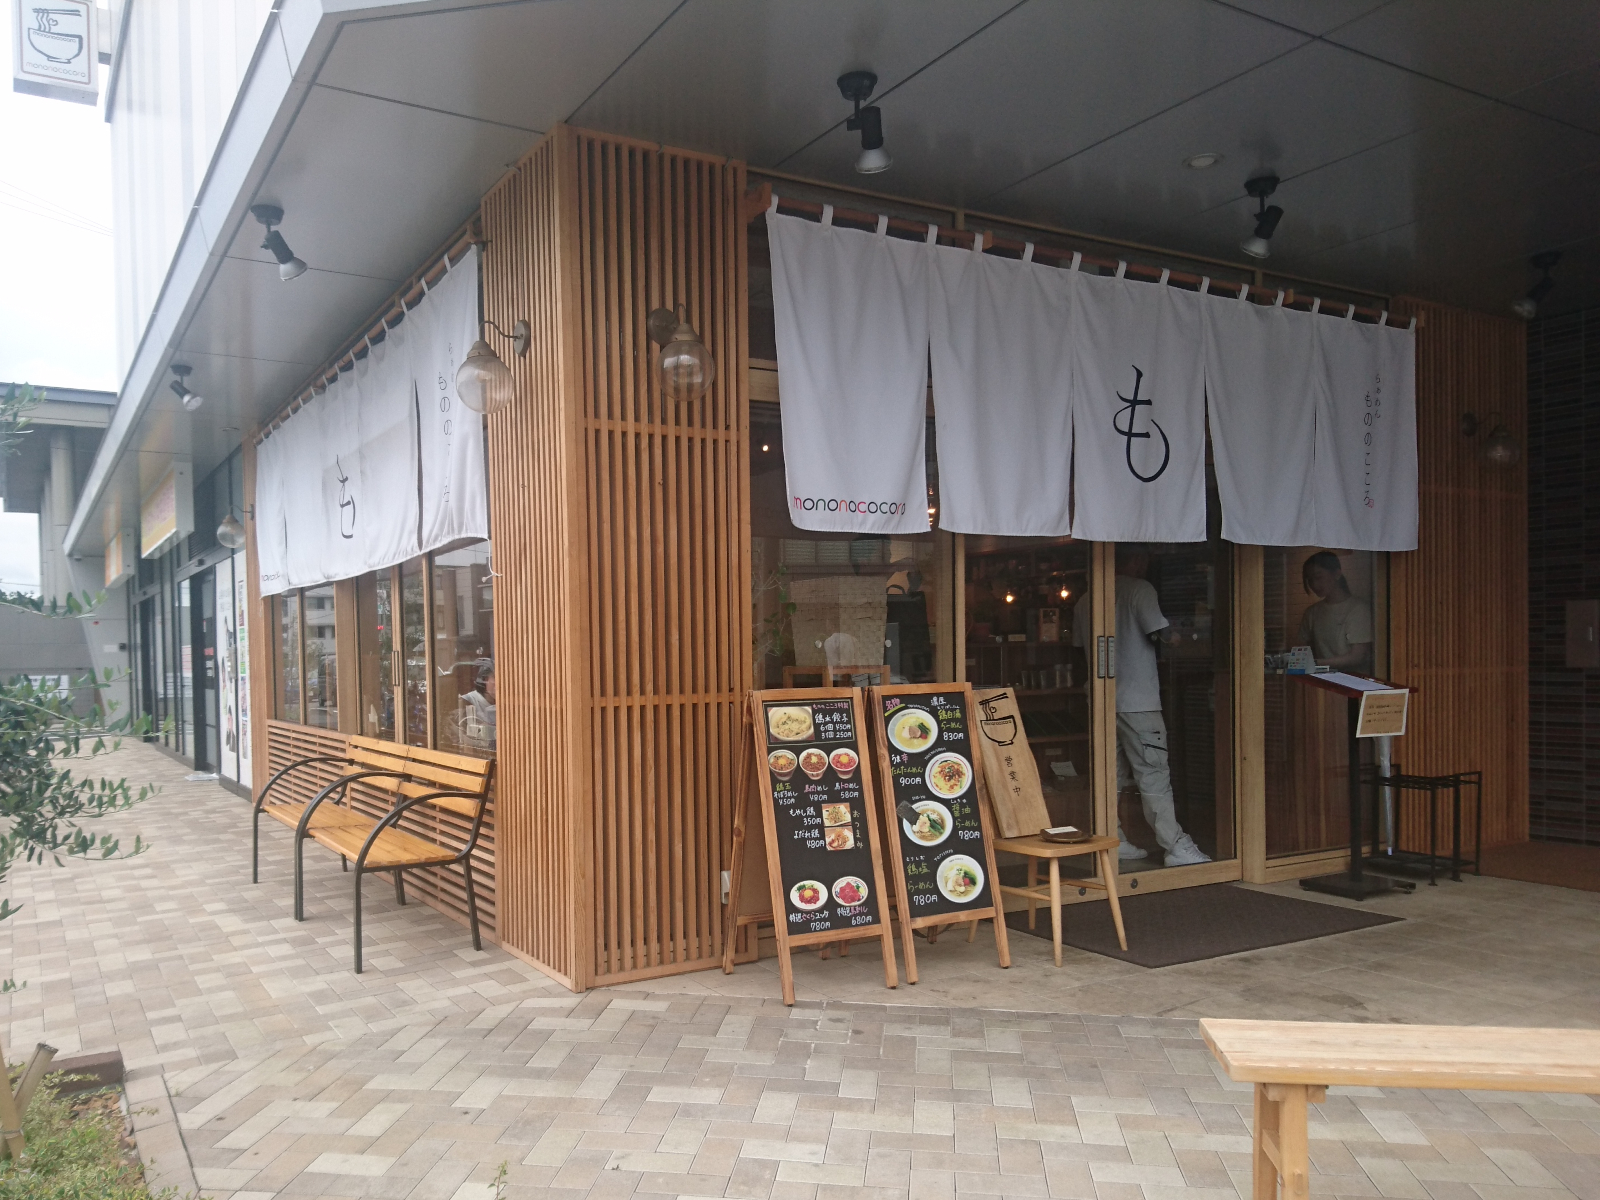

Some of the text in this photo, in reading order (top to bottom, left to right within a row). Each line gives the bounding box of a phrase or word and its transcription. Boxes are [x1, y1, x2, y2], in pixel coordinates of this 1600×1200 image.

[25, 61, 86, 77] mononococoro
[1113, 364, 1170, 482] も
[1364, 391, 1372, 505] もののこころ
[793, 496, 906, 515] mononococoro
[930, 696, 947, 707] 濃厚
[938, 708, 962, 720] 鶏白湯
[941, 721, 962, 730] らーめん
[943, 732, 964, 741] 830円
[891, 765, 924, 777] たんたんめん
[1004, 755, 1021, 797] 営業中
[899, 776, 922, 786] 900円
[809, 794, 828, 802] 480円
[840, 791, 859, 799] 580円
[789, 806, 816, 817] もやし鶏
[951, 803, 971, 817] 醤油
[803, 818, 822, 826] 350円
[955, 818, 978, 829] らーめん
[852, 810, 864, 850] おつまみ
[958, 830, 980, 840] 780円
[806, 840, 825, 849] 480円
[906, 862, 930, 876] 鶏塩
[907, 880, 934, 893] らーめん
[913, 893, 938, 906] 780円
[851, 915, 872, 926] 680円
[810, 921, 831, 932] 780円
